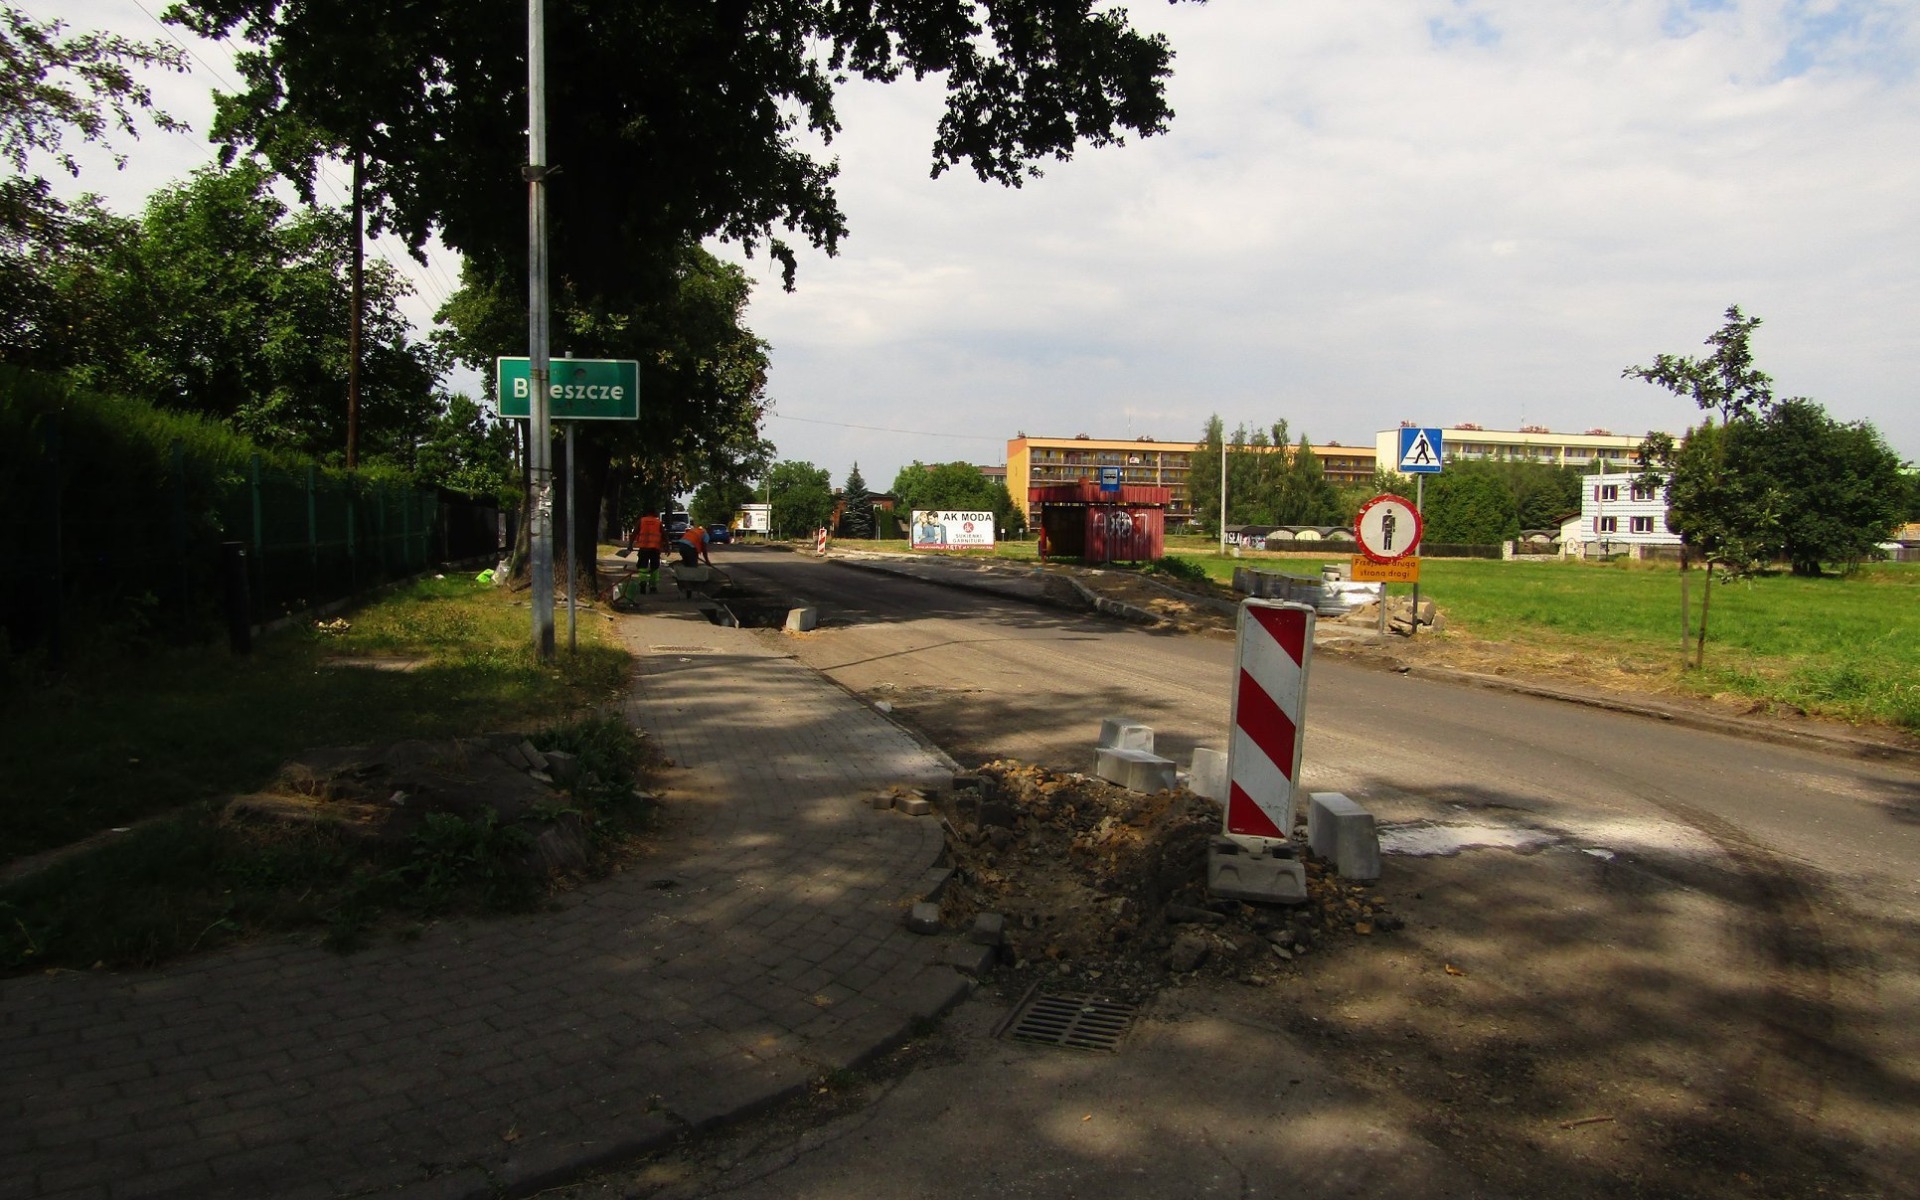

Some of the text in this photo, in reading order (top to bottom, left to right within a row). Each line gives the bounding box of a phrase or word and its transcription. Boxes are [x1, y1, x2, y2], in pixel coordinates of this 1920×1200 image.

[514, 377, 624, 400] Beszcze
[943, 513, 992, 521] AK MODA
[1355, 559, 1389, 567] Przej
[1388, 570, 1410, 579] drogi
